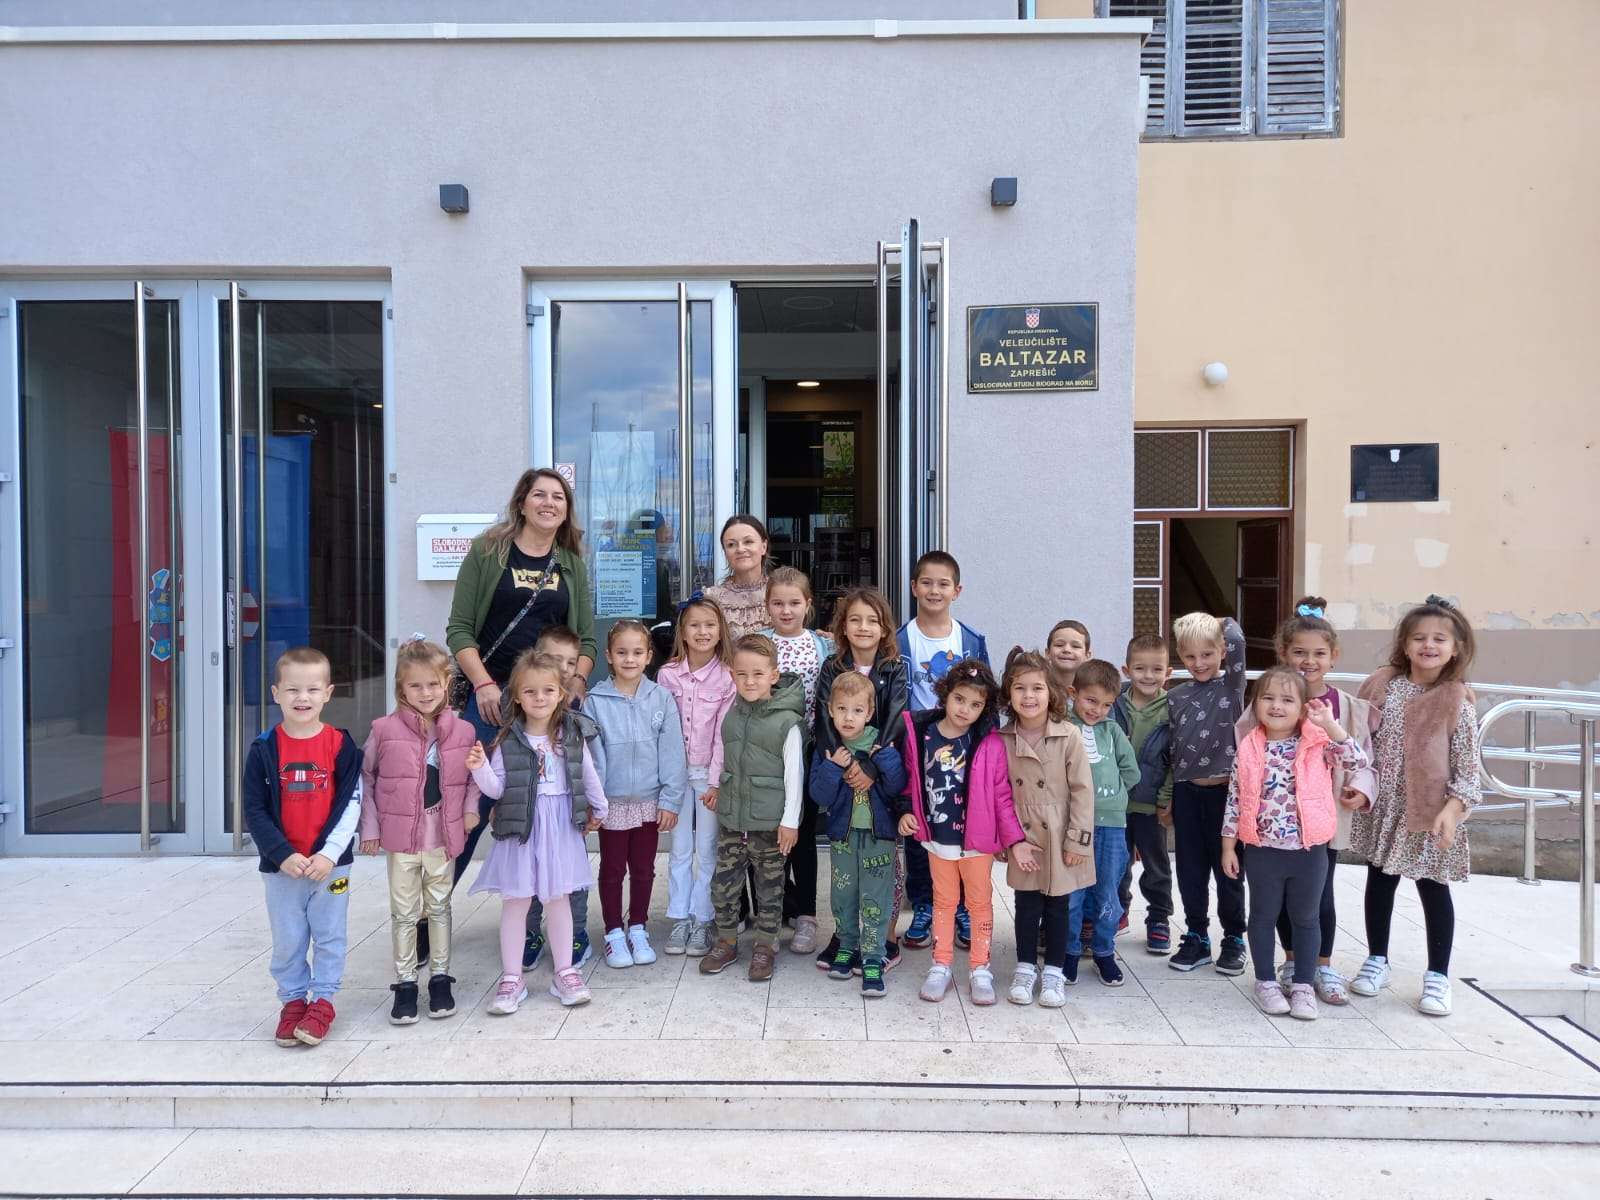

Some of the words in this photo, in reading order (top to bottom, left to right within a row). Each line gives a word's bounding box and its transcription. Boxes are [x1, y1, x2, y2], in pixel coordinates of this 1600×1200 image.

[999, 337, 1068, 347] VELEUČILIŠTE
[979, 349, 1087, 367] BALTAZAR
[1010, 367, 1057, 378] ZAPREŠIĆ
